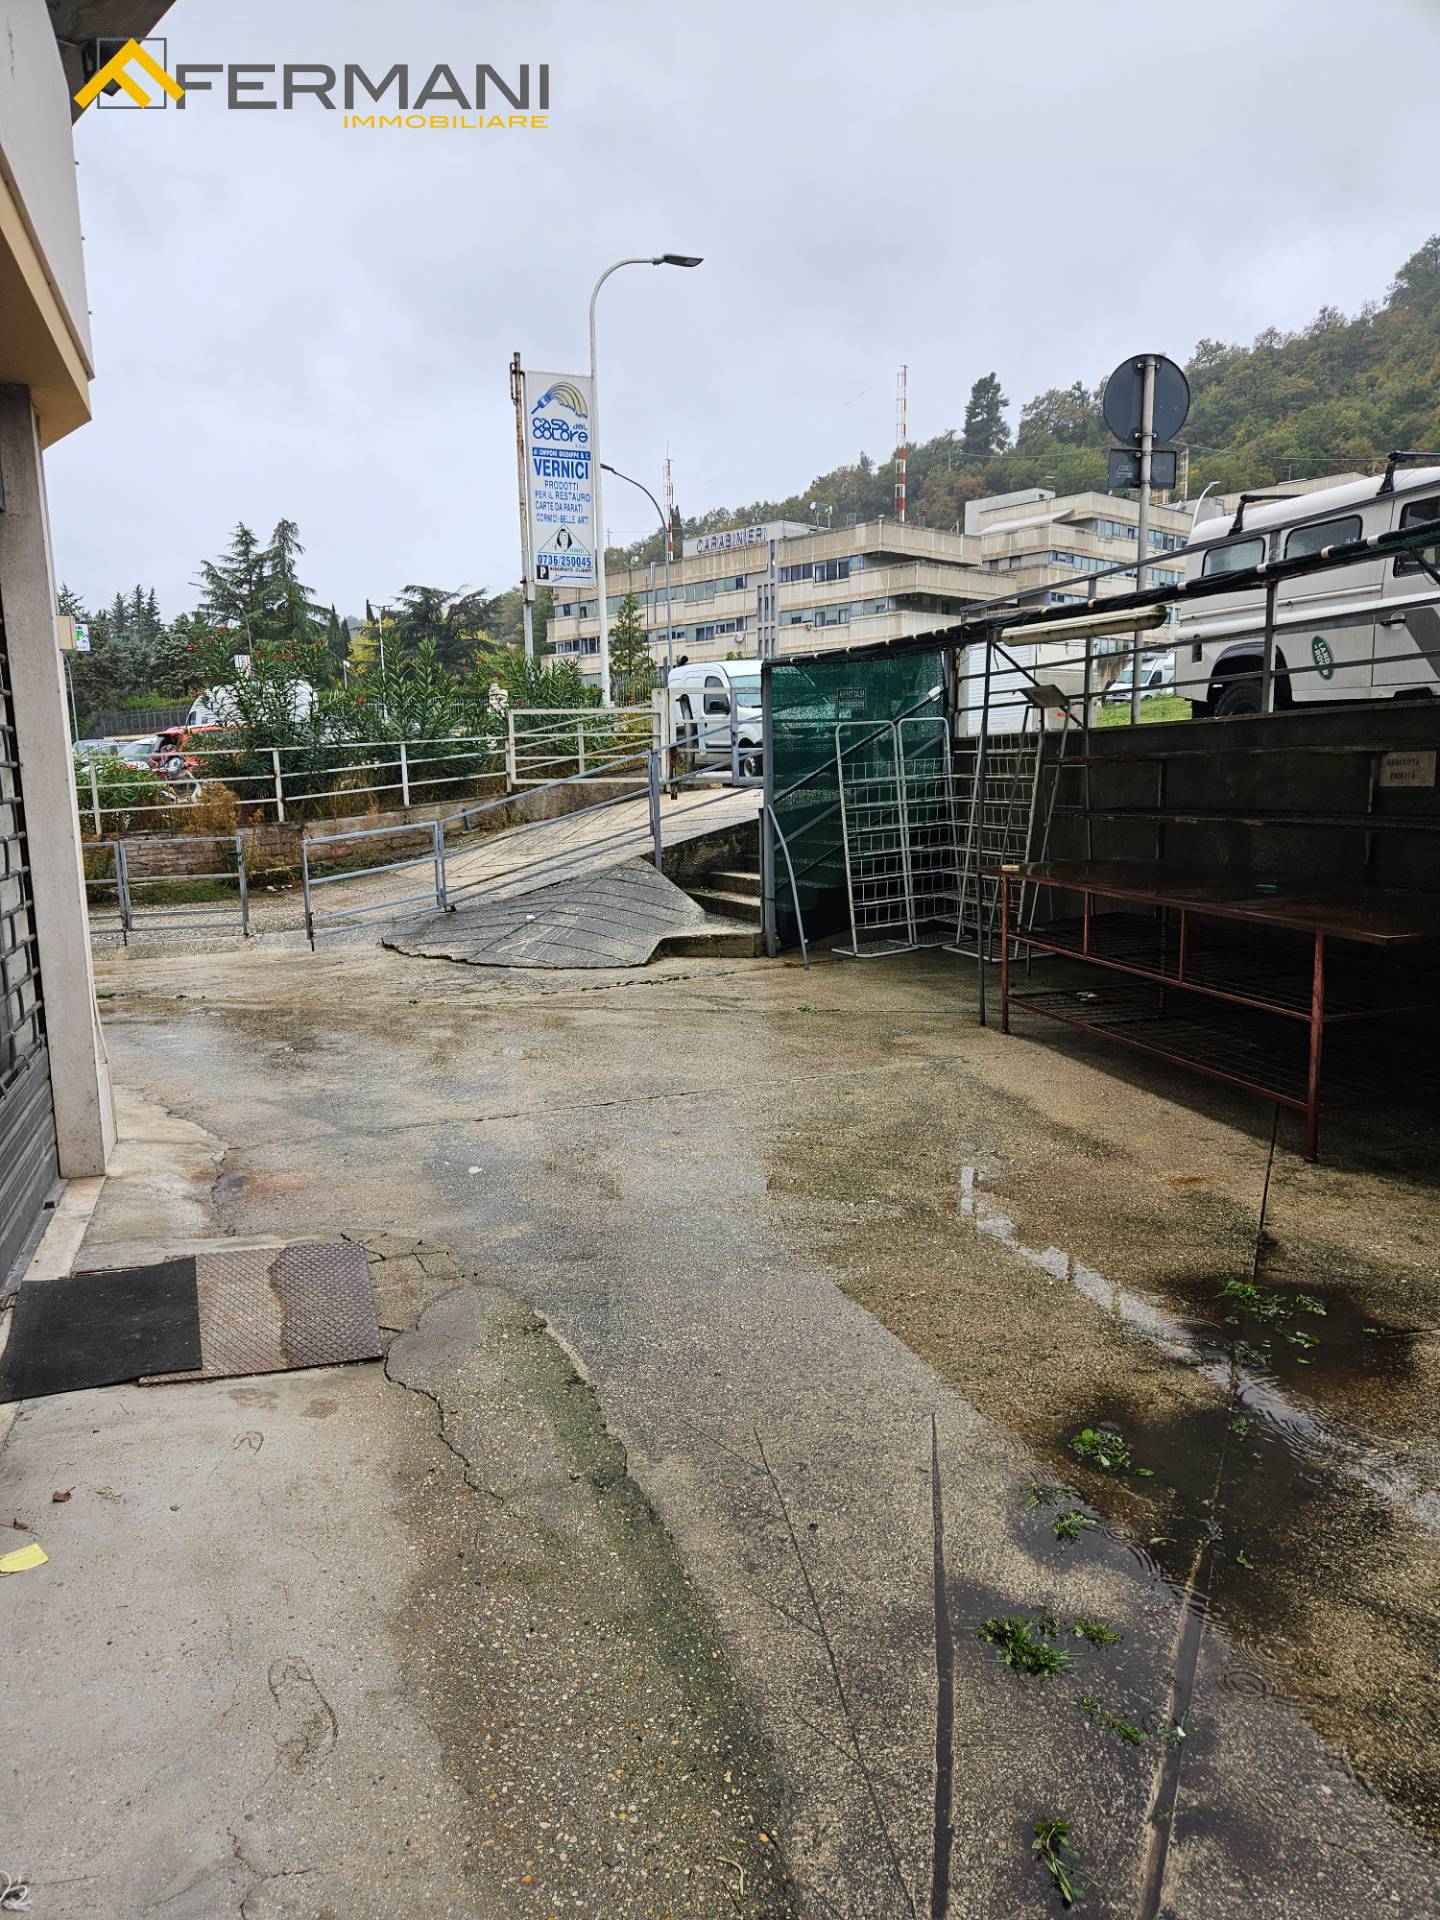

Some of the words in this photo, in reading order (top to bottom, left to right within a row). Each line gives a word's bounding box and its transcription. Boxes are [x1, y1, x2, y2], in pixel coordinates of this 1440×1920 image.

[533, 459, 589, 480] VERNICI
[544, 479, 579, 491] PRODOTTI
[535, 490, 546, 499] PER
[547, 491, 554, 500] IL
[555, 491, 591, 502] RESTAURO
[535, 500, 554, 511] CARTE
[555, 502, 562, 511] DA
[563, 503, 583, 513] PARATI
[697, 527, 767, 553] CARABINIERI
[537, 554, 592, 567] 0736/250045
[1318, 642, 1331, 664] LAND
[1314, 649, 1329, 676] ROVR
